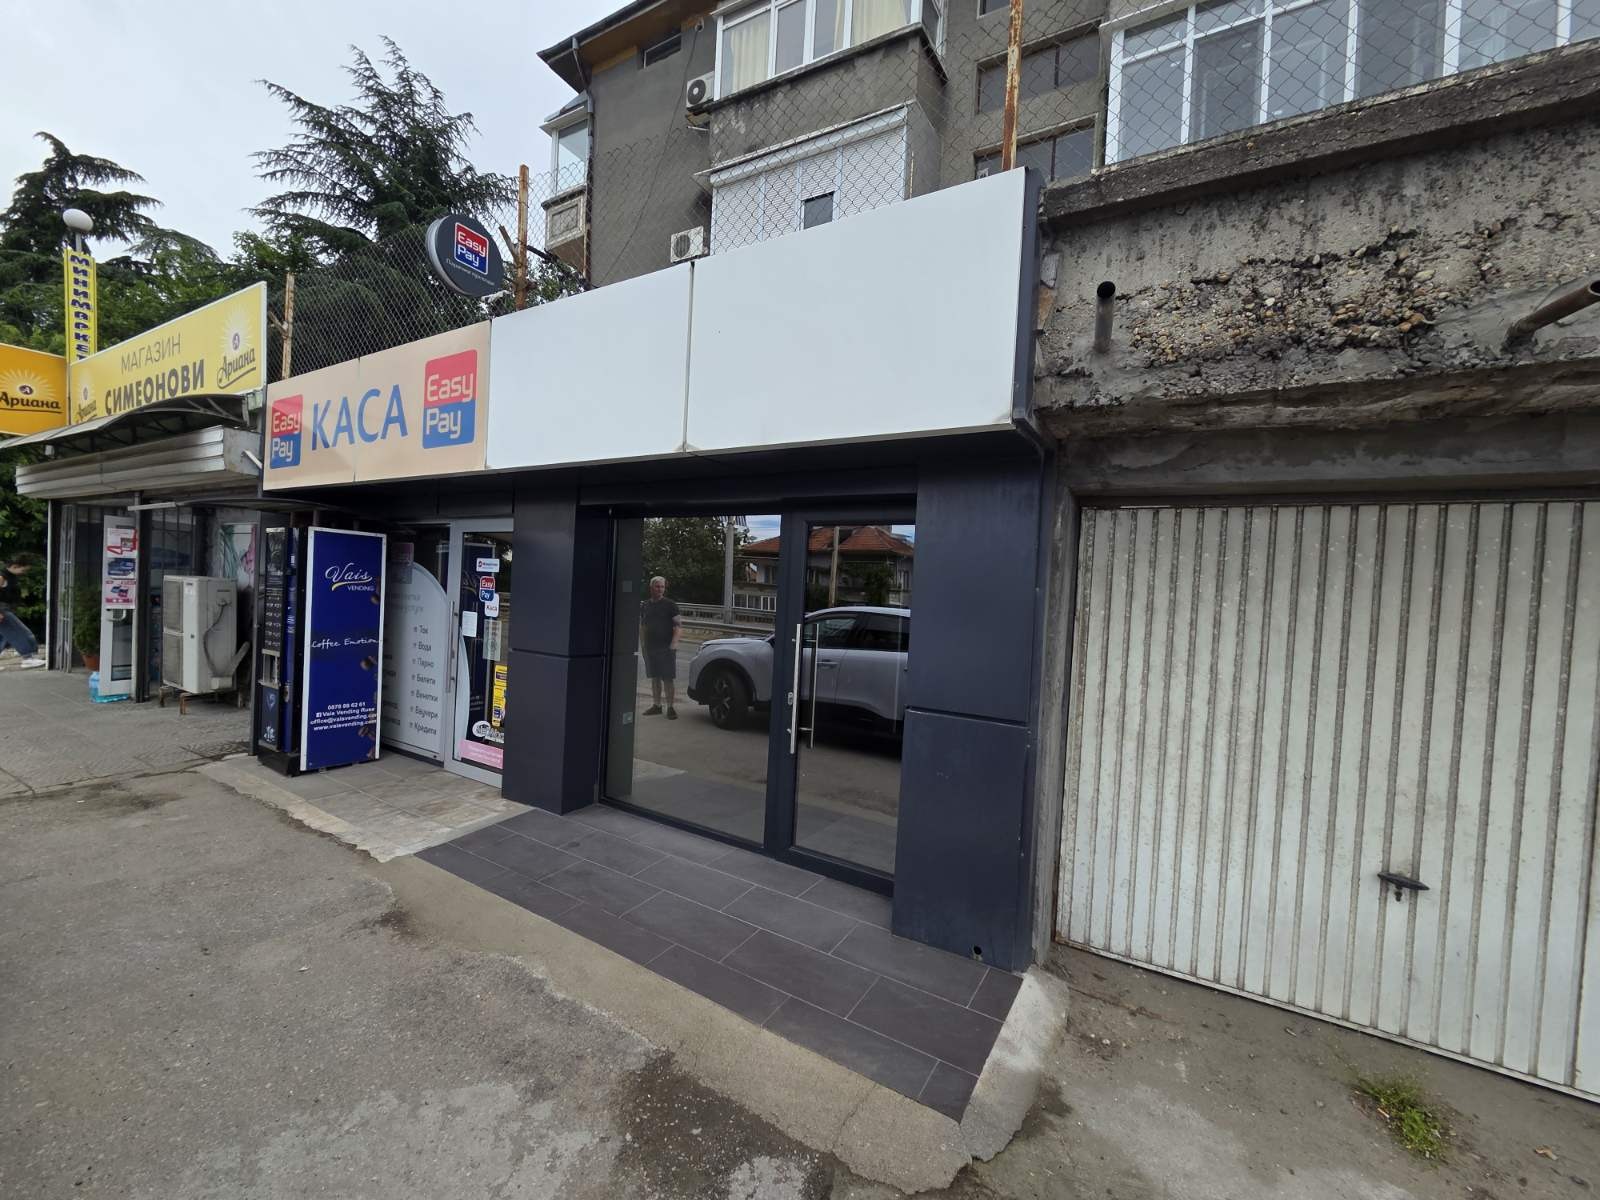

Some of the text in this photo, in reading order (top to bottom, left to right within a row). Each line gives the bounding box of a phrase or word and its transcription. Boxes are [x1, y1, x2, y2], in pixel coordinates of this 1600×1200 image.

[457, 231, 486, 258] Easy
[457, 244, 480, 267] Pay
[121, 333, 181, 374] МАГАЗИН
[217, 347, 256, 384] Ариана
[0, 391, 62, 411] Ариана
[105, 359, 205, 416] СИМЕОНОВИ
[427, 372, 474, 403] Easy
[273, 411, 301, 435] Easy
[312, 384, 408, 451] КАСА
[426, 408, 462, 439] Pay
[272, 437, 293, 462] Pay
[325, 562, 372, 583] Vais
[311, 638, 341, 650] Coffee
